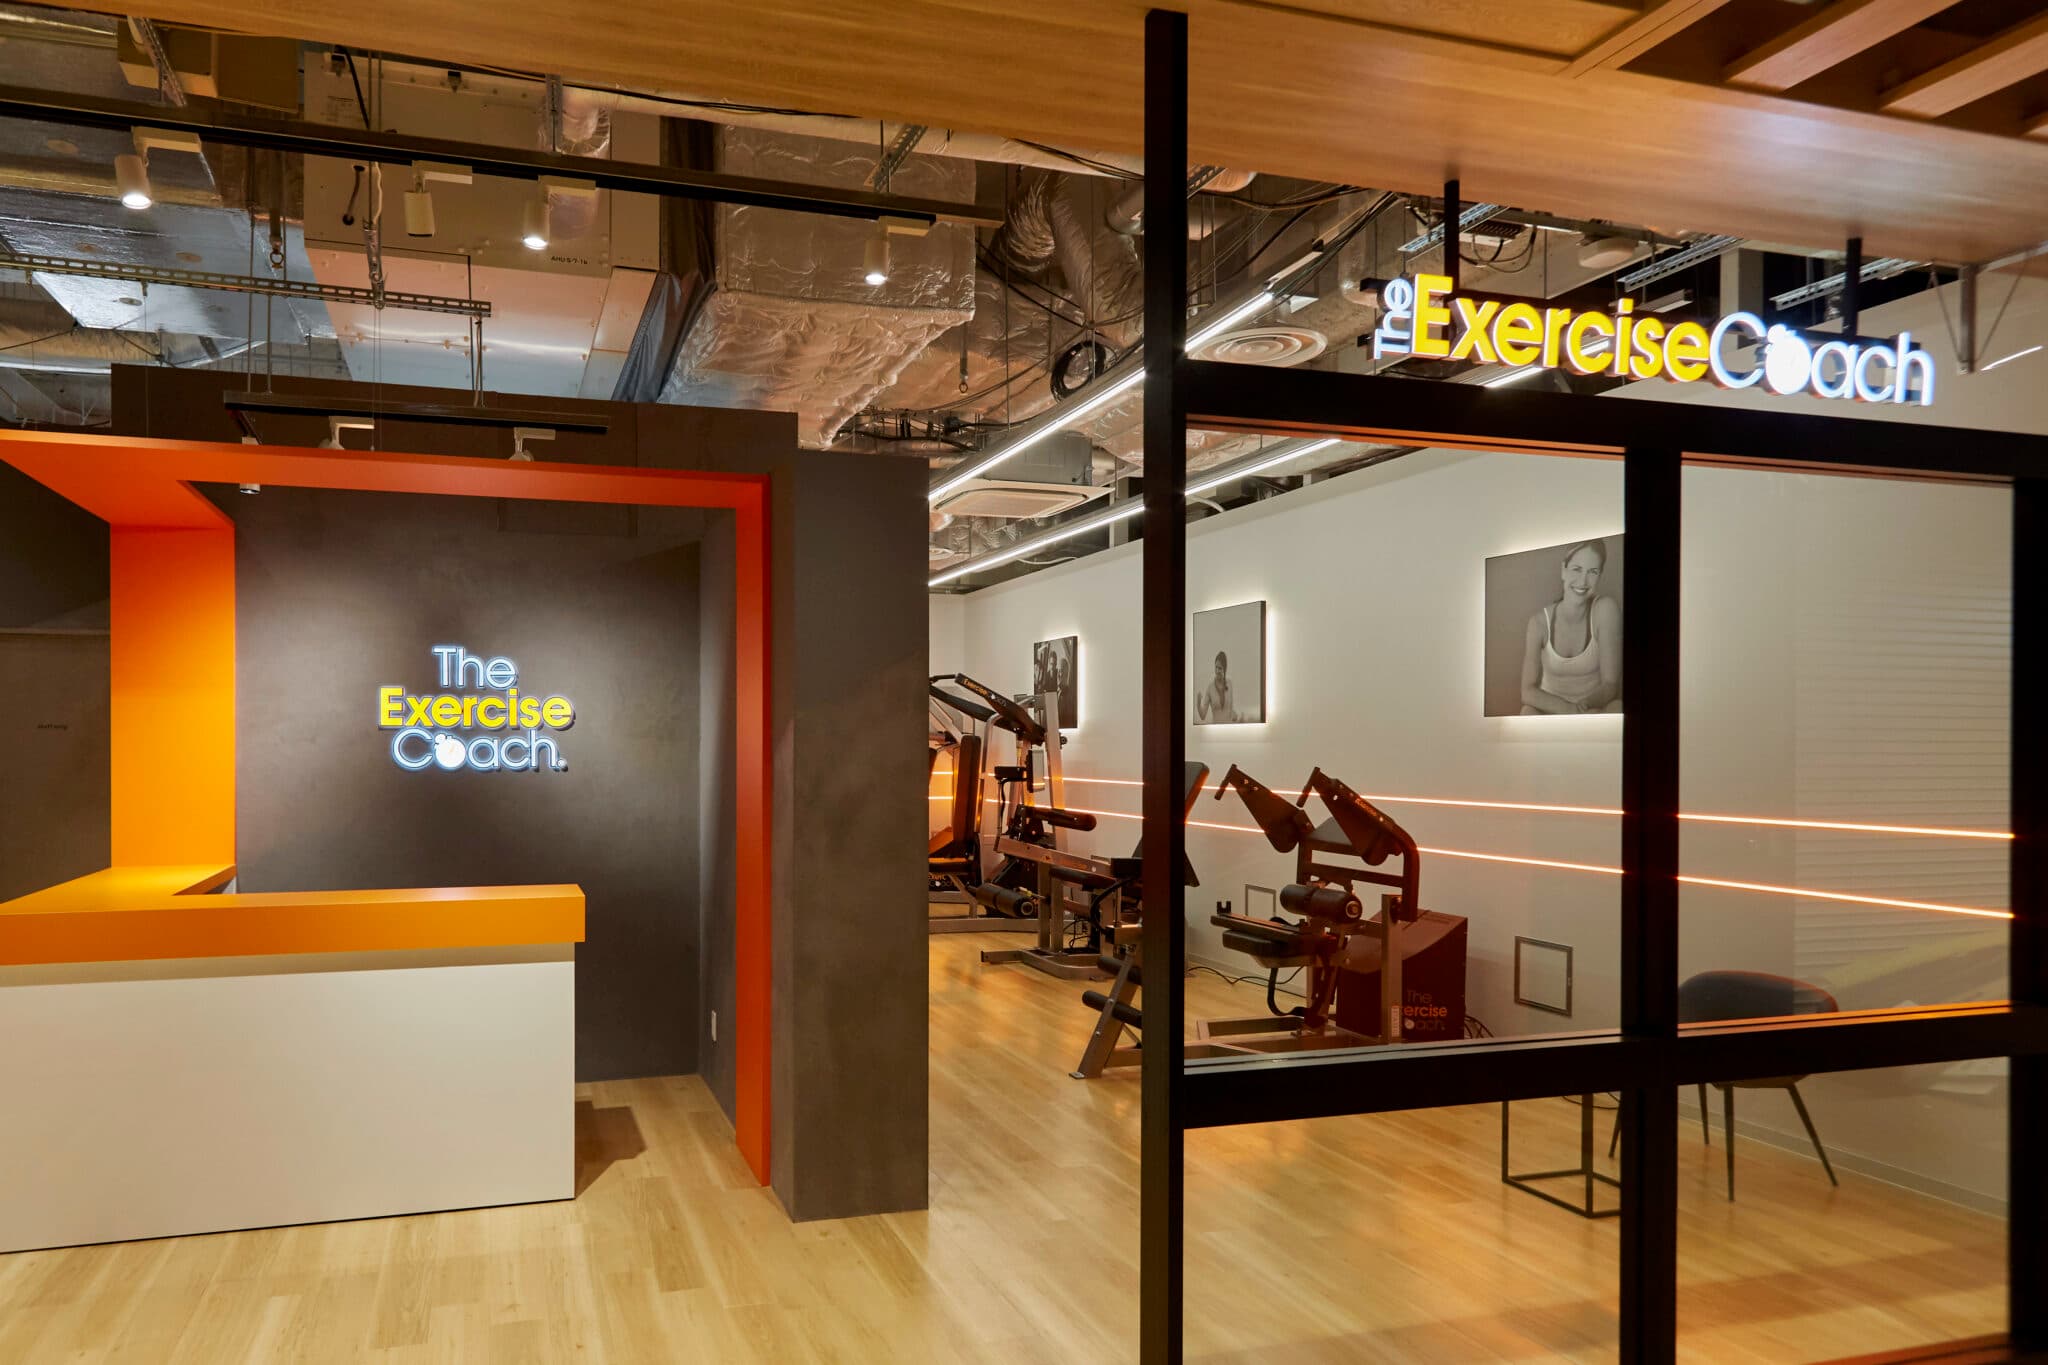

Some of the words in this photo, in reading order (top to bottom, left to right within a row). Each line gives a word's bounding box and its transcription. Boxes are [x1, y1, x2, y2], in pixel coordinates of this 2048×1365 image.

[1374, 277, 1413, 360] The
[433, 646, 517, 689] The
[379, 687, 574, 728] Exercise
[1401, 1003, 1448, 1017] ercise
